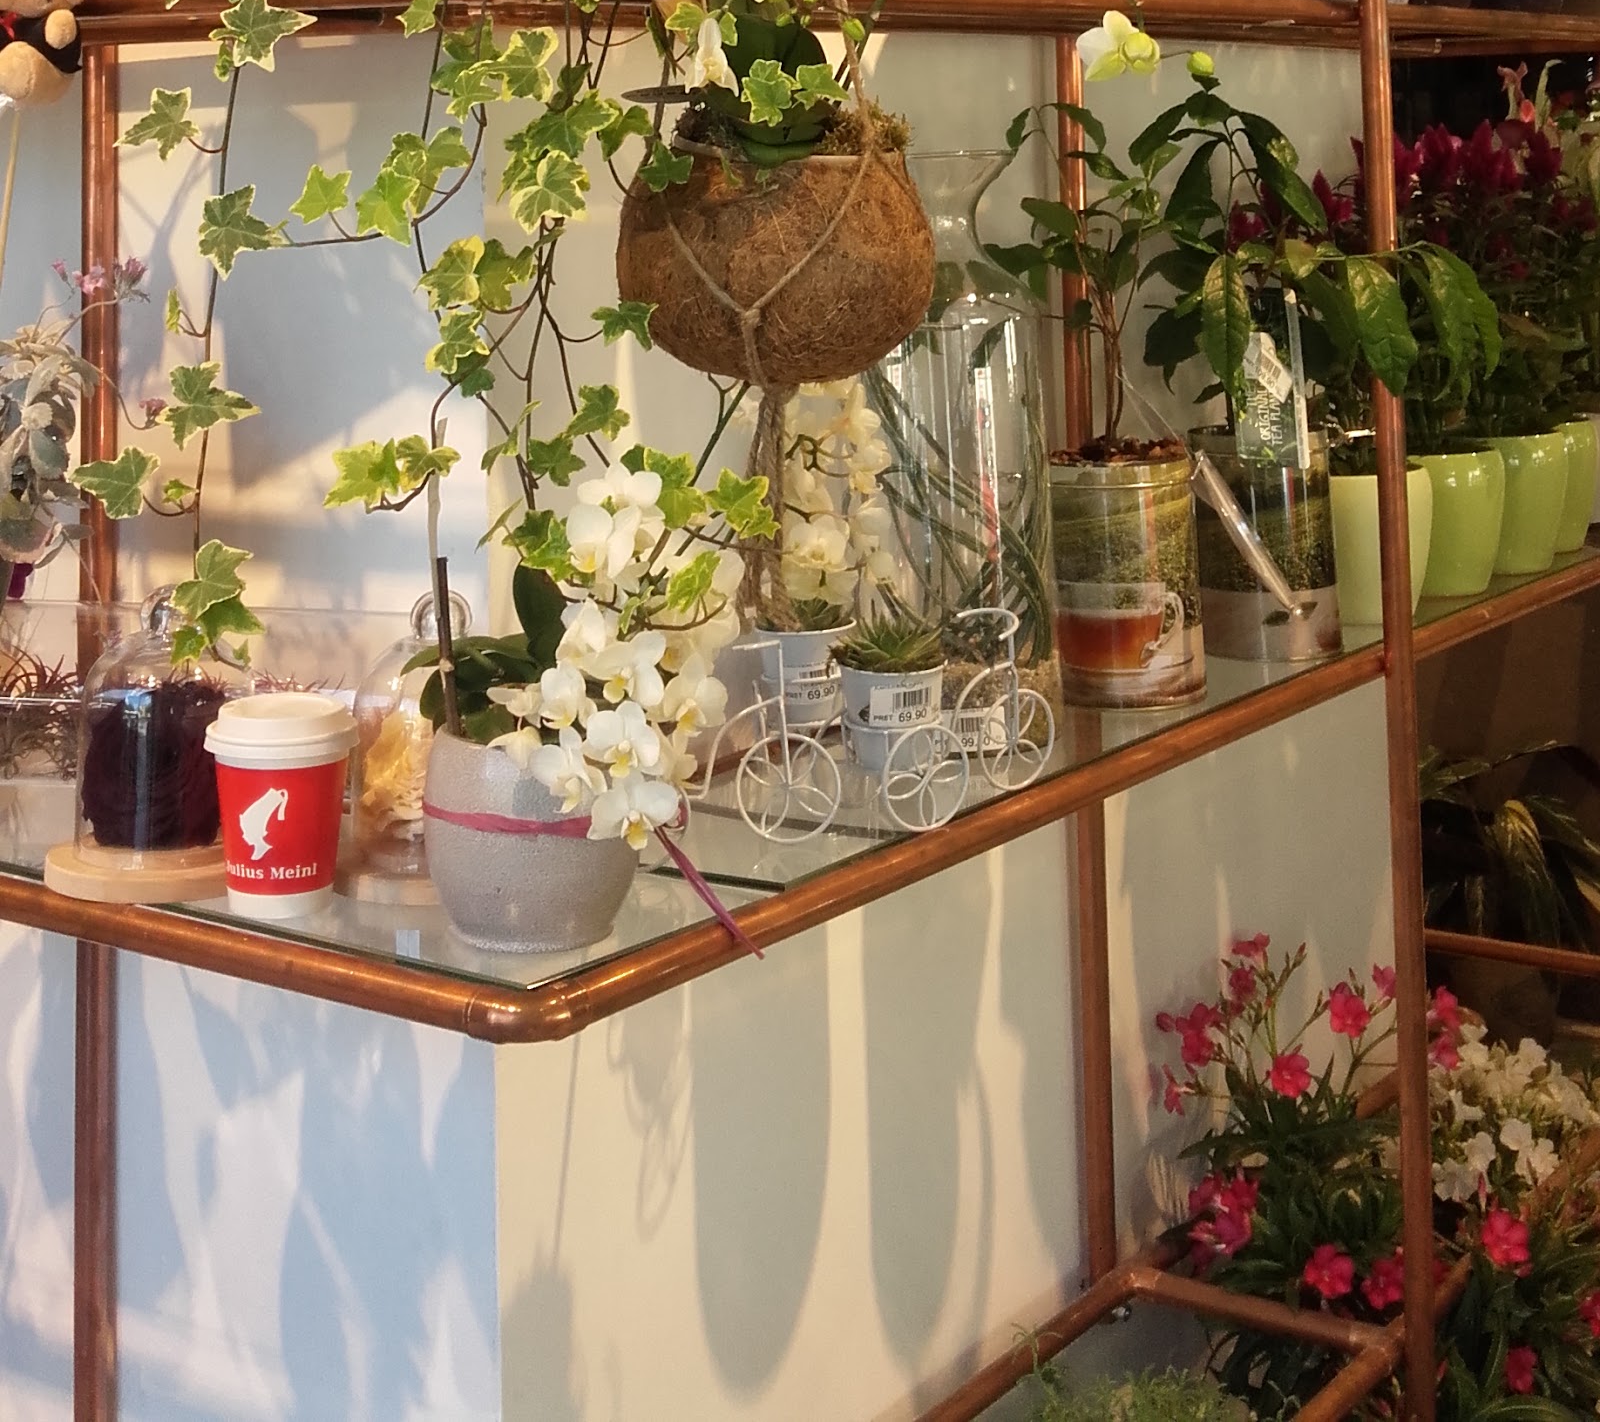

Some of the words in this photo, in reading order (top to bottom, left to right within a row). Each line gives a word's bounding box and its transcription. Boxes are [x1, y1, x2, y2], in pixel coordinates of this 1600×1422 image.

[1270, 424, 1283, 447] TEA
[807, 685, 835, 700] 69.90
[898, 708, 927, 723] 69.90
[961, 737, 991, 748] 99.0
[226, 859, 264, 879] Julius
[270, 862, 317, 880] Meinl
